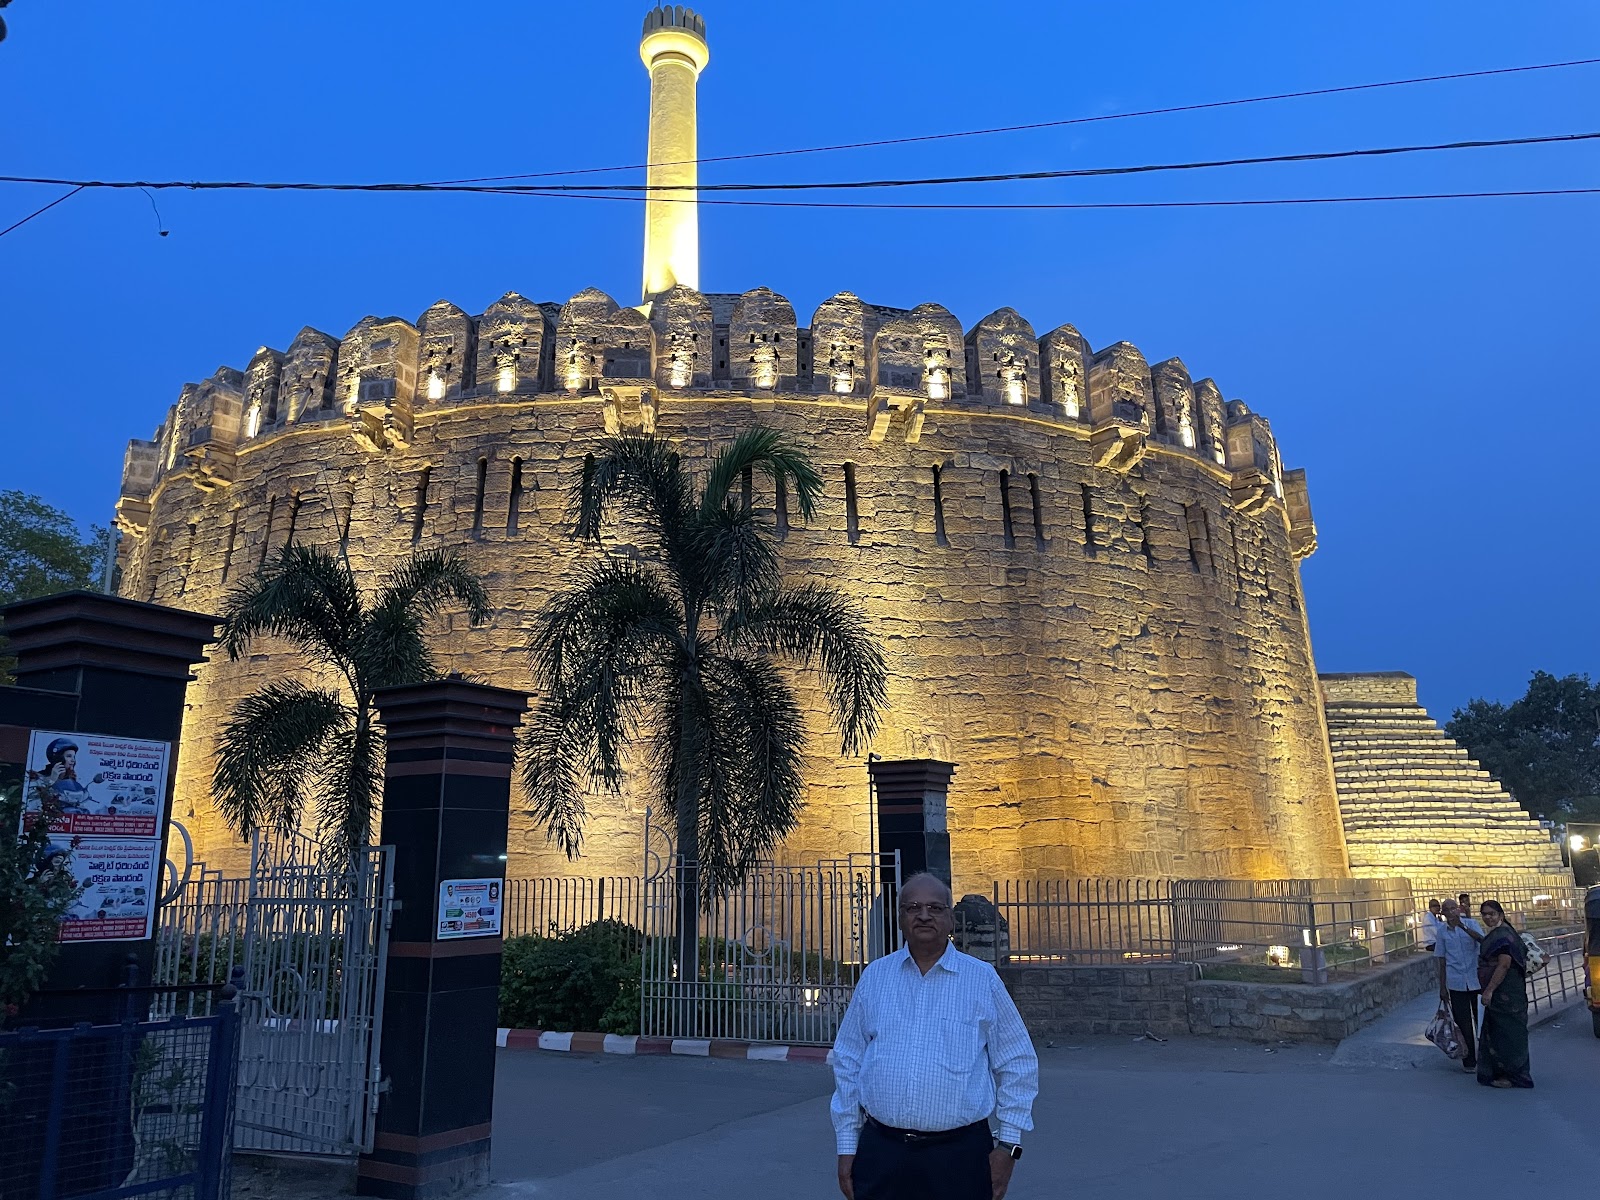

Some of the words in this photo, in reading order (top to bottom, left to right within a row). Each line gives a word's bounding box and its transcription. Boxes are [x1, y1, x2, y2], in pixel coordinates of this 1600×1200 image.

[100, 758, 124, 769] హెల్మెట్
[126, 760, 159, 770] ధరించండి
[102, 771, 121, 782] రక్షణ
[89, 861, 114, 872] హెల్మెట్
[115, 861, 149, 870] ధరించండి
[92, 874, 110, 885] రక్షణ
